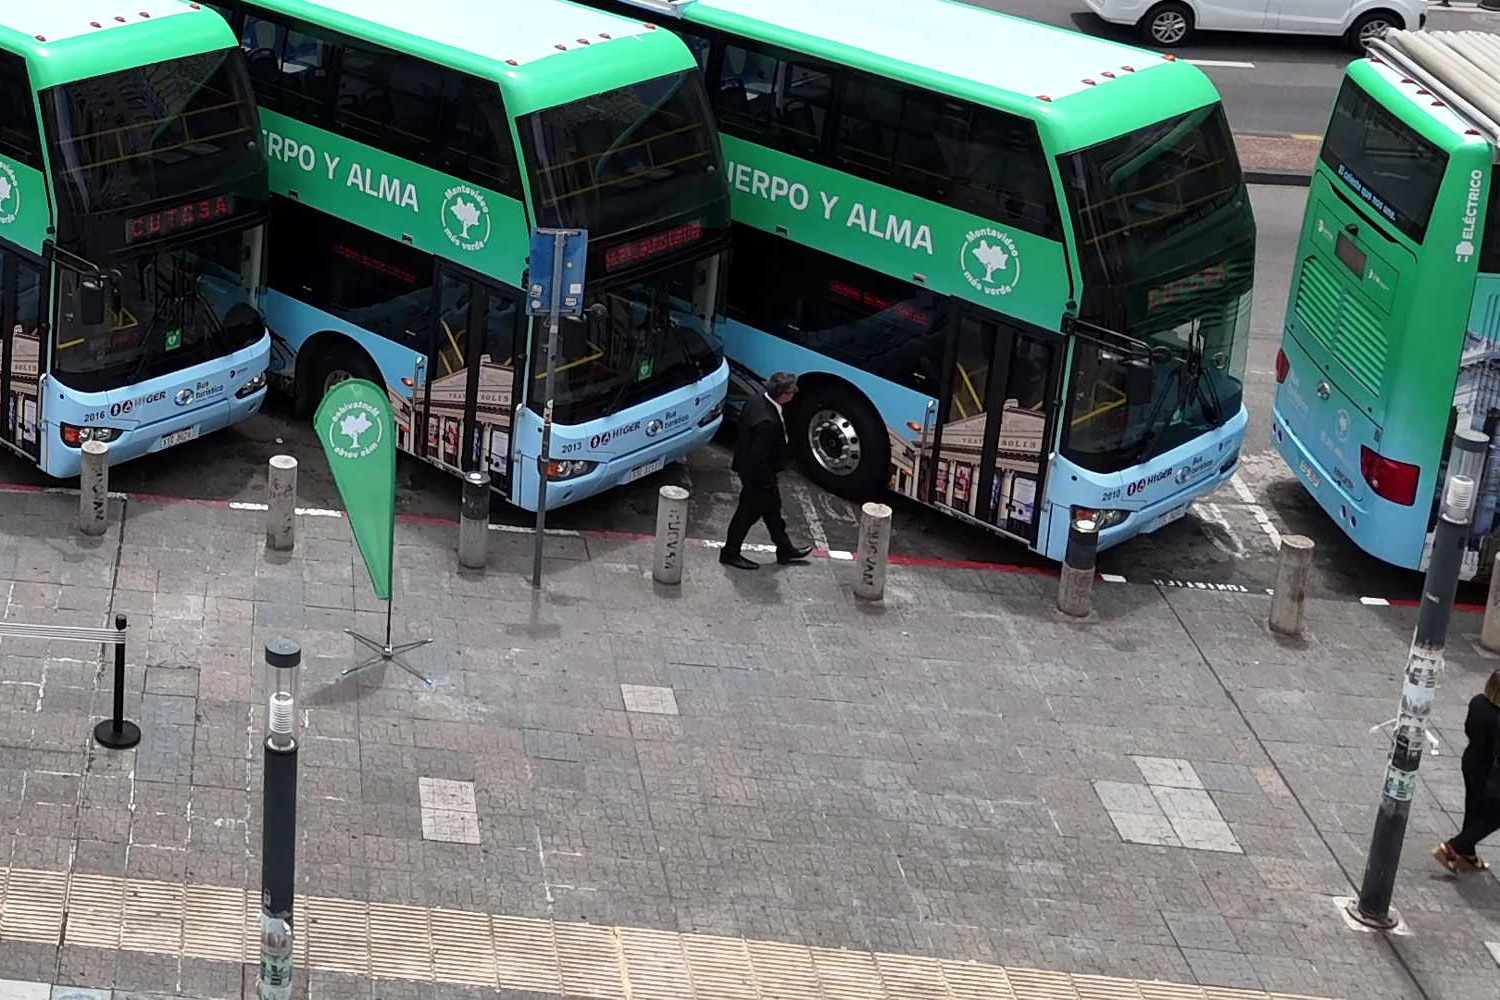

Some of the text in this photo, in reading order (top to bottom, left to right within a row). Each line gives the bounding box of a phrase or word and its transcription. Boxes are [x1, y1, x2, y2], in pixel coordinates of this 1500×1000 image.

[323, 151, 340, 180] Y
[346, 163, 419, 213] ALMA
[1338, 164, 1346, 176] El
[1372, 195, 1384, 210] nos
[444, 184, 489, 213] Montevideo
[1462, 169, 1483, 240] ELÉCTRICO
[129, 195, 228, 237] CUTCSA
[820, 190, 933, 255] Y ALMA
[444, 226, 485, 251] más verde
[964, 226, 1019, 257] Montevideo
[963, 270, 1013, 296] más verde
[196, 380, 209, 391] Bus
[480, 394, 509, 402] SOLIS
[134, 390, 167, 407] HIGER
[84, 411, 106, 422] 2016
[612, 420, 641, 439] HIGER
[561, 441, 582, 454] 2013
[1001, 439, 1037, 449] SOLIS
[1147, 467, 1173, 486] HIGER
